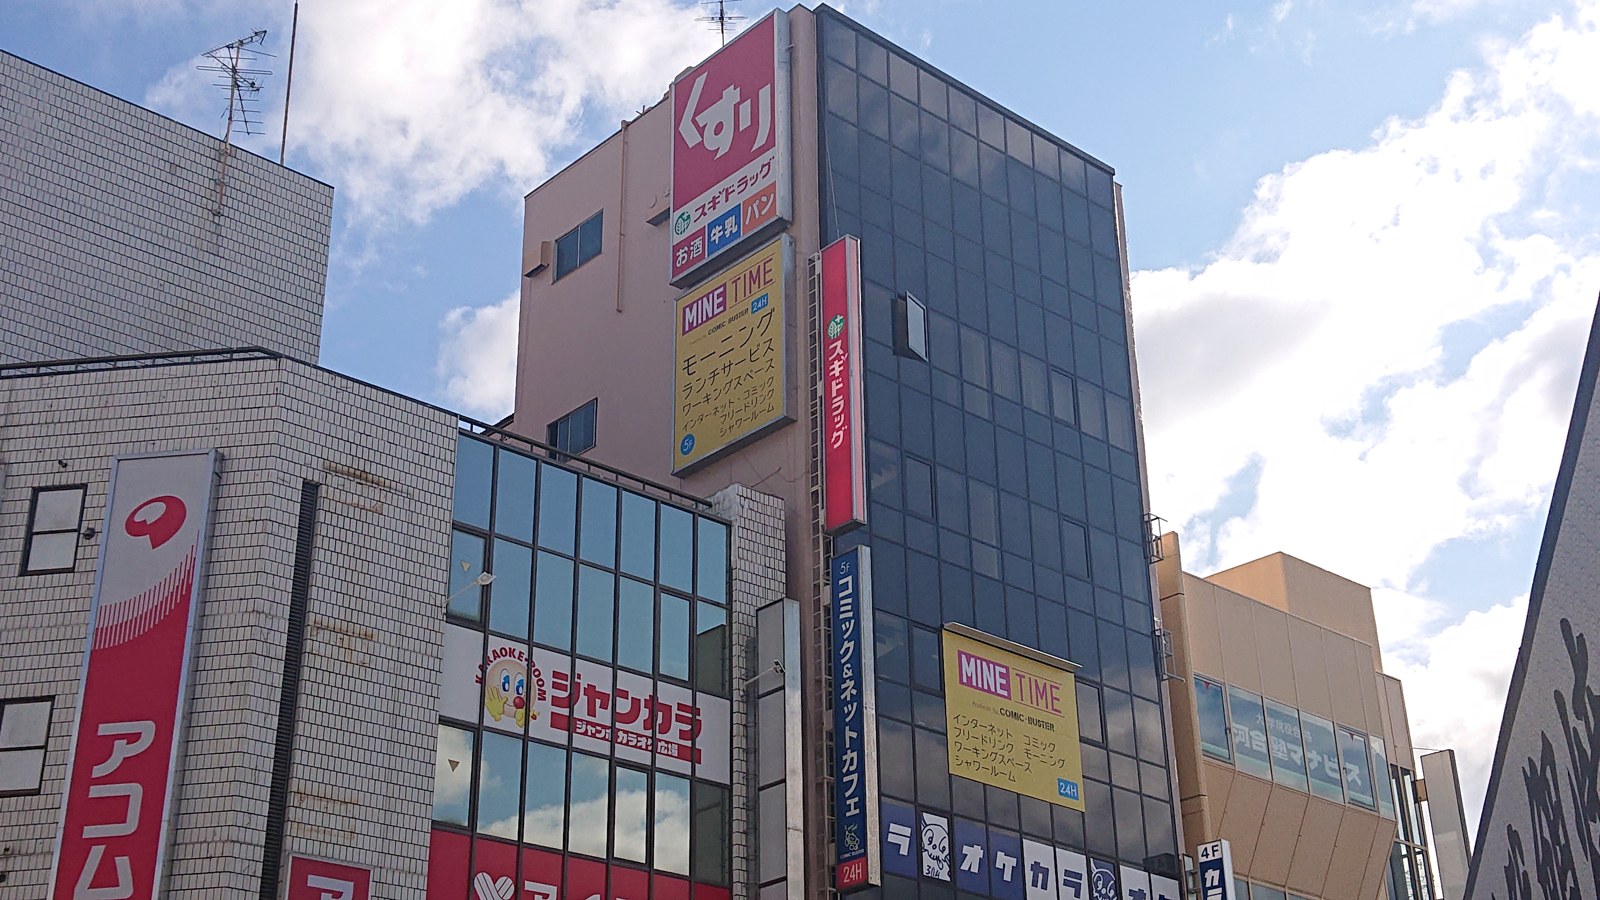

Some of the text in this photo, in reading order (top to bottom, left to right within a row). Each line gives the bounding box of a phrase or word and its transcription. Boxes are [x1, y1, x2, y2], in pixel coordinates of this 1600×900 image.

[678, 71, 771, 160] くすり
[693, 156, 775, 224] スギドラッグ
[675, 192, 775, 268] お酒 牛乳 パン
[684, 257, 774, 332] MINE TIME
[752, 296, 767, 312] 24H
[682, 307, 775, 376] モーニング
[682, 338, 775, 400] ランチサービス
[682, 357, 775, 417] ワーキングスペース
[719, 388, 775, 425] フリードリンク
[828, 339, 849, 449] スギドラッグ
[719, 403, 775, 438] シャワールーム
[550, 670, 703, 743] ジャンカラ
[838, 574, 861, 818] コミック&ネットカフェ
[961, 654, 1063, 714] MINE TIME
[953, 714, 1056, 752] インターネット コミック
[953, 727, 1066, 769] フリードリンク モーニング
[953, 741, 1033, 774] ワーキングスペース
[1232, 722, 1362, 786] 河合塾マナビス
[954, 755, 1017, 783] シャワールーム
[1059, 782, 1078, 797] 24H
[74, 719, 156, 900] アコム
[843, 862, 862, 883] 24H
[1201, 844, 1219, 859] 4F
